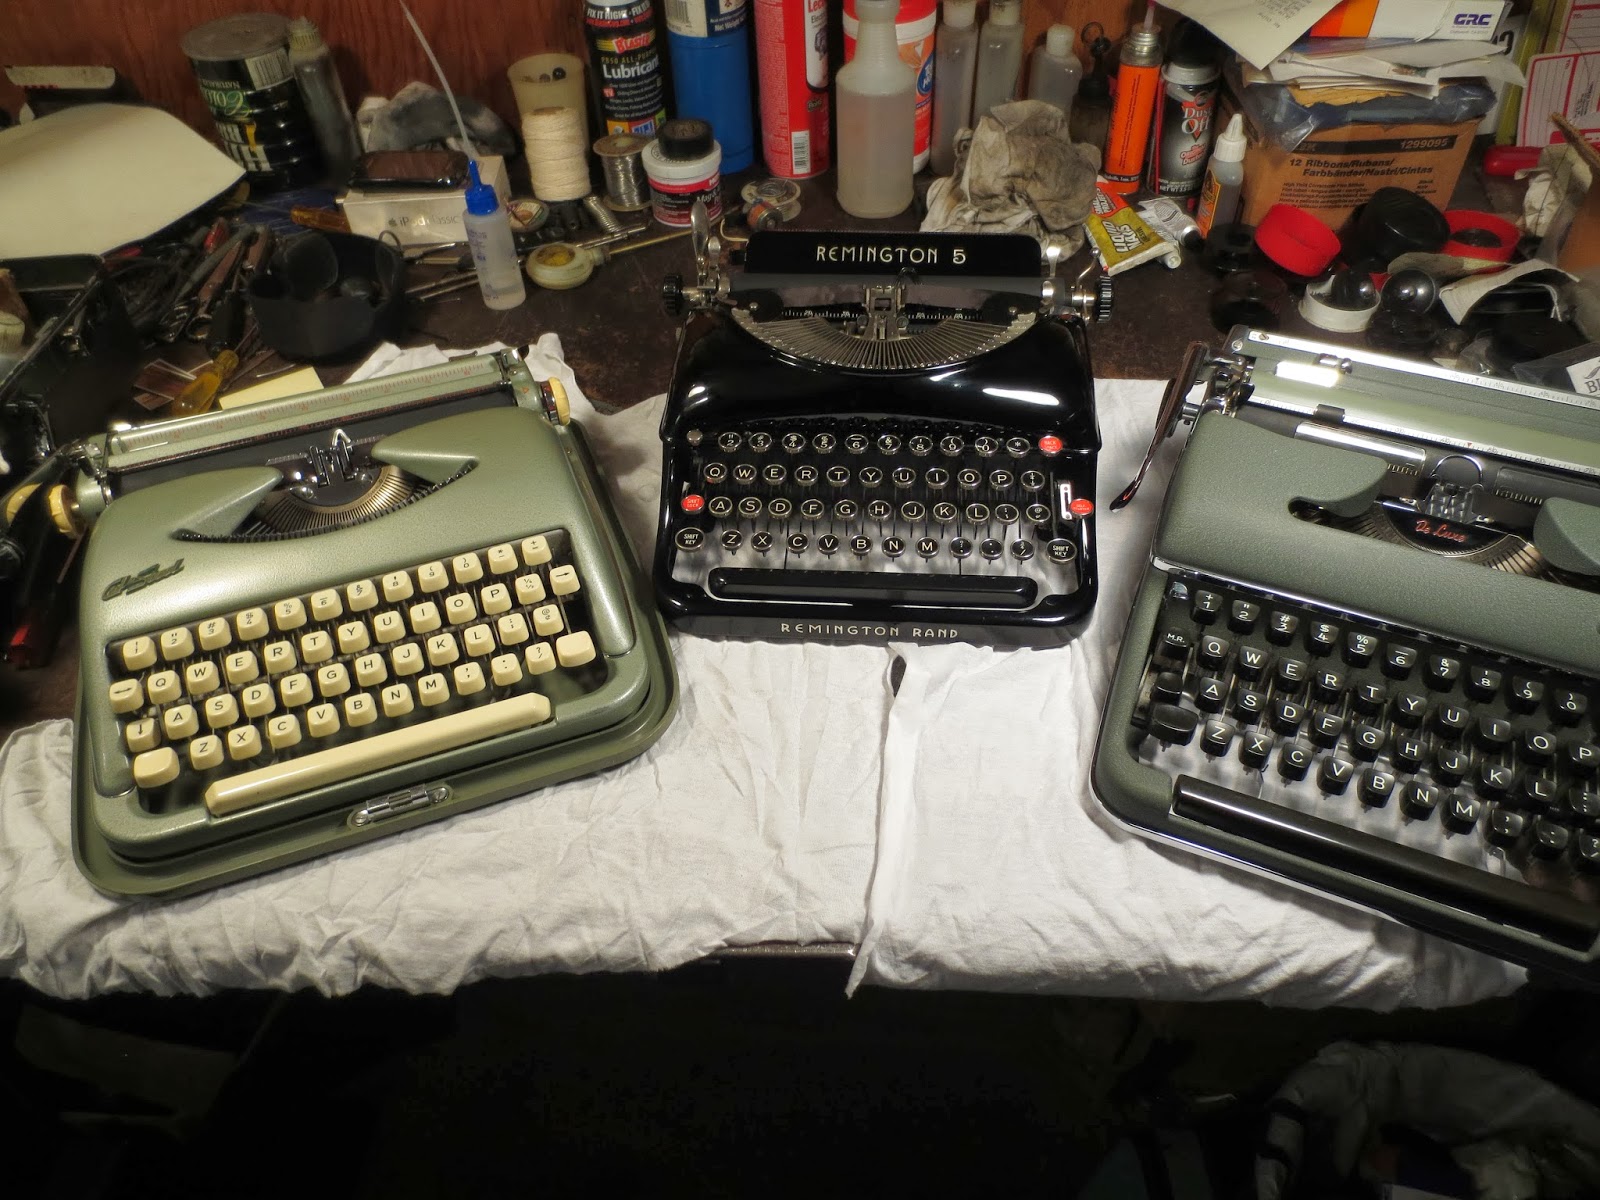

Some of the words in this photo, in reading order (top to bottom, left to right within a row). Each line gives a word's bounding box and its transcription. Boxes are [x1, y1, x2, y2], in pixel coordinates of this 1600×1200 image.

[586, 8, 596, 18] FIX
[597, 10, 604, 19] IT
[604, 8, 628, 20] RIGHT
[1454, 14, 1492, 25] GRC
[1181, 117, 1210, 134] Off
[1400, 138, 1448, 150] 1299095
[1290, 159, 1302, 167] 12
[1306, 158, 1395, 169] Ribbons/Rubans/
[1303, 166, 1433, 178] Farbbänder/Nastri/Cintas
[1102, 220, 1130, 252] LIQUID
[816, 246, 938, 264] REMINGTON
[952, 248, 966, 264] 5
[1585, 380, 1600, 394] B
[948, 442, 956, 451] 9
[981, 443, 990, 451] 0
[709, 467, 720, 477] Q
[738, 468, 751, 478] W
[770, 469, 779, 478] E
[801, 470, 811, 479] R
[834, 471, 844, 480] T
[866, 472, 876, 481] Y
[899, 472, 909, 482] U
[964, 473, 975, 483] O
[997, 474, 1007, 483] P
[715, 500, 725, 510] A
[745, 501, 756, 511] S
[775, 503, 786, 512] D
[809, 504, 818, 513] F
[839, 504, 851, 514] G
[874, 505, 884, 515] H
[908, 506, 917, 516] J
[940, 507, 950, 516] K
[974, 507, 983, 517] L
[1415, 520, 1432, 534] De
[1433, 524, 1468, 543] Luxe
[727, 534, 737, 544] Z
[757, 535, 768, 545] X
[792, 537, 803, 546] C
[824, 538, 834, 548] V
[856, 540, 866, 549] B
[889, 540, 899, 550] N
[921, 541, 933, 551] M
[155, 677, 166, 688] Q
[194, 667, 206, 677] W
[235, 657, 243, 667] E
[273, 647, 283, 656] R
[310, 637, 319, 646] T
[346, 627, 356, 636] Y
[382, 616, 392, 626] U
[454, 598, 464, 608] O
[491, 588, 500, 598] P
[780, 622, 900, 638] REMINGTON
[912, 627, 959, 639] RAND
[1166, 633, 1185, 643] M.R.
[1238, 611, 1248, 619] 2
[1278, 622, 1288, 632] 3
[1317, 633, 1328, 641] 4
[1355, 644, 1366, 653] 5
[1395, 655, 1406, 665] 6
[1440, 667, 1449, 677] 7
[1481, 677, 1491, 687] 8
[1523, 689, 1532, 699] 9
[1566, 701, 1577, 710] 0
[173, 712, 183, 722] A
[214, 701, 224, 711] S
[251, 690, 261, 700] D
[289, 680, 298, 690] F
[326, 670, 337, 680] G
[363, 660, 373, 670] H
[402, 649, 411, 659] J
[436, 639, 446, 649] K
[474, 631, 481, 640] L
[1208, 642, 1221, 654] Q
[1246, 651, 1261, 664] W
[1286, 664, 1298, 676] E
[1324, 674, 1337, 686] R
[1366, 686, 1379, 698] T
[1406, 698, 1419, 710] Y
[1447, 709, 1459, 722] U
[1533, 735, 1549, 750] O
[1579, 746, 1592, 759] P
[200, 743, 208, 753] Z
[237, 732, 246, 742] X
[277, 721, 287, 731] C
[316, 710, 326, 720] V
[354, 700, 363, 710] B
[391, 690, 400, 700] N
[426, 679, 437, 689] M
[1206, 684, 1219, 696] A
[1244, 695, 1256, 706] S
[1283, 706, 1296, 718] D
[1322, 718, 1335, 729] F
[1362, 732, 1376, 744] G
[1405, 742, 1418, 756] H
[1446, 758, 1458, 769] J
[1490, 770, 1502, 784] K
[1535, 782, 1546, 796] L
[1211, 726, 1226, 739] Z
[1251, 737, 1264, 751] X
[1291, 751, 1304, 763] C
[1332, 762, 1346, 776] V
[1373, 776, 1385, 790] B
[1417, 788, 1429, 802] N
[1456, 801, 1473, 817] M
